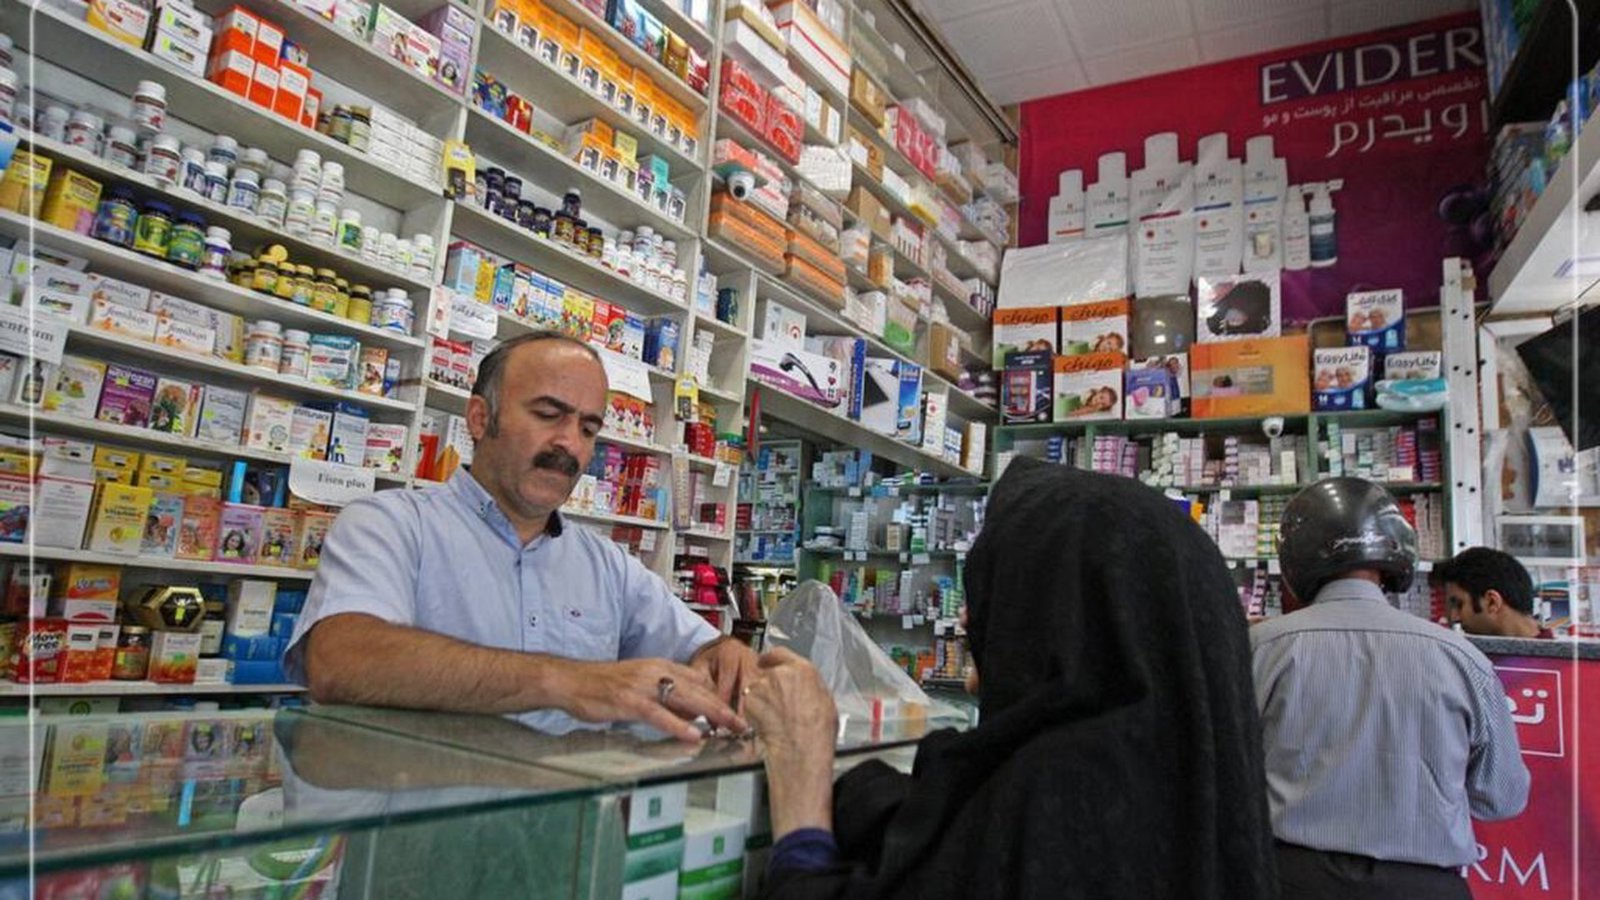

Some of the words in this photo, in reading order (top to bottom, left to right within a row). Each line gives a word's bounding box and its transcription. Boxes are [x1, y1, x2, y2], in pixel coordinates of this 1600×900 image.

[1316, 351, 1367, 365] EasyLife
[1386, 356, 1439, 369] EasyLife
[345, 476, 366, 489] plus
